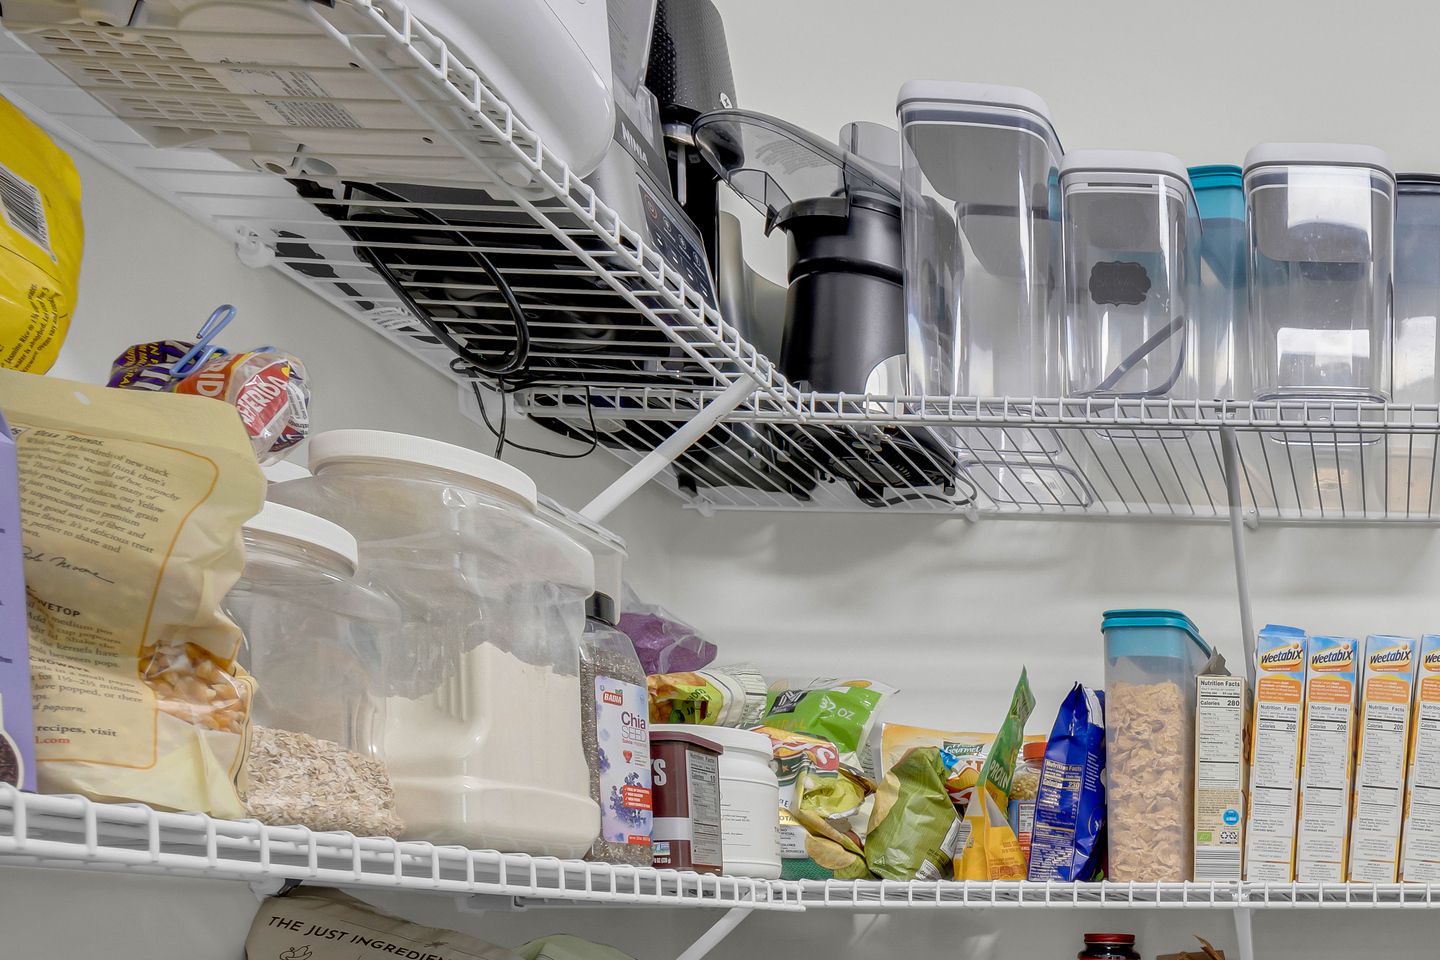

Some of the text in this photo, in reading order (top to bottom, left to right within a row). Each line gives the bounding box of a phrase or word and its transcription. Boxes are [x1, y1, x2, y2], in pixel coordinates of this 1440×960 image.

[125, 458, 143, 468] new
[145, 463, 169, 477] snack
[110, 501, 135, 515] whole
[135, 510, 159, 523] grain
[138, 500, 165, 513] Yellow
[101, 511, 140, 527] premium
[74, 533, 100, 546] share
[90, 527, 129, 545] delicious
[57, 643, 118, 658] kernels have
[1261, 649, 1302, 664] Weetabix
[1311, 649, 1353, 665] Weetabix
[1370, 650, 1412, 664] Weetabix
[59, 684, 102, 696] popped,
[604, 693, 621, 704] BADIA
[818, 698, 856, 721] 32 OZ
[621, 711, 645, 729] Chia
[37, 725, 117, 736] recipes, visit
[622, 725, 647, 742] SEED
[268, 916, 304, 931] THE
[304, 925, 349, 941] JUST
